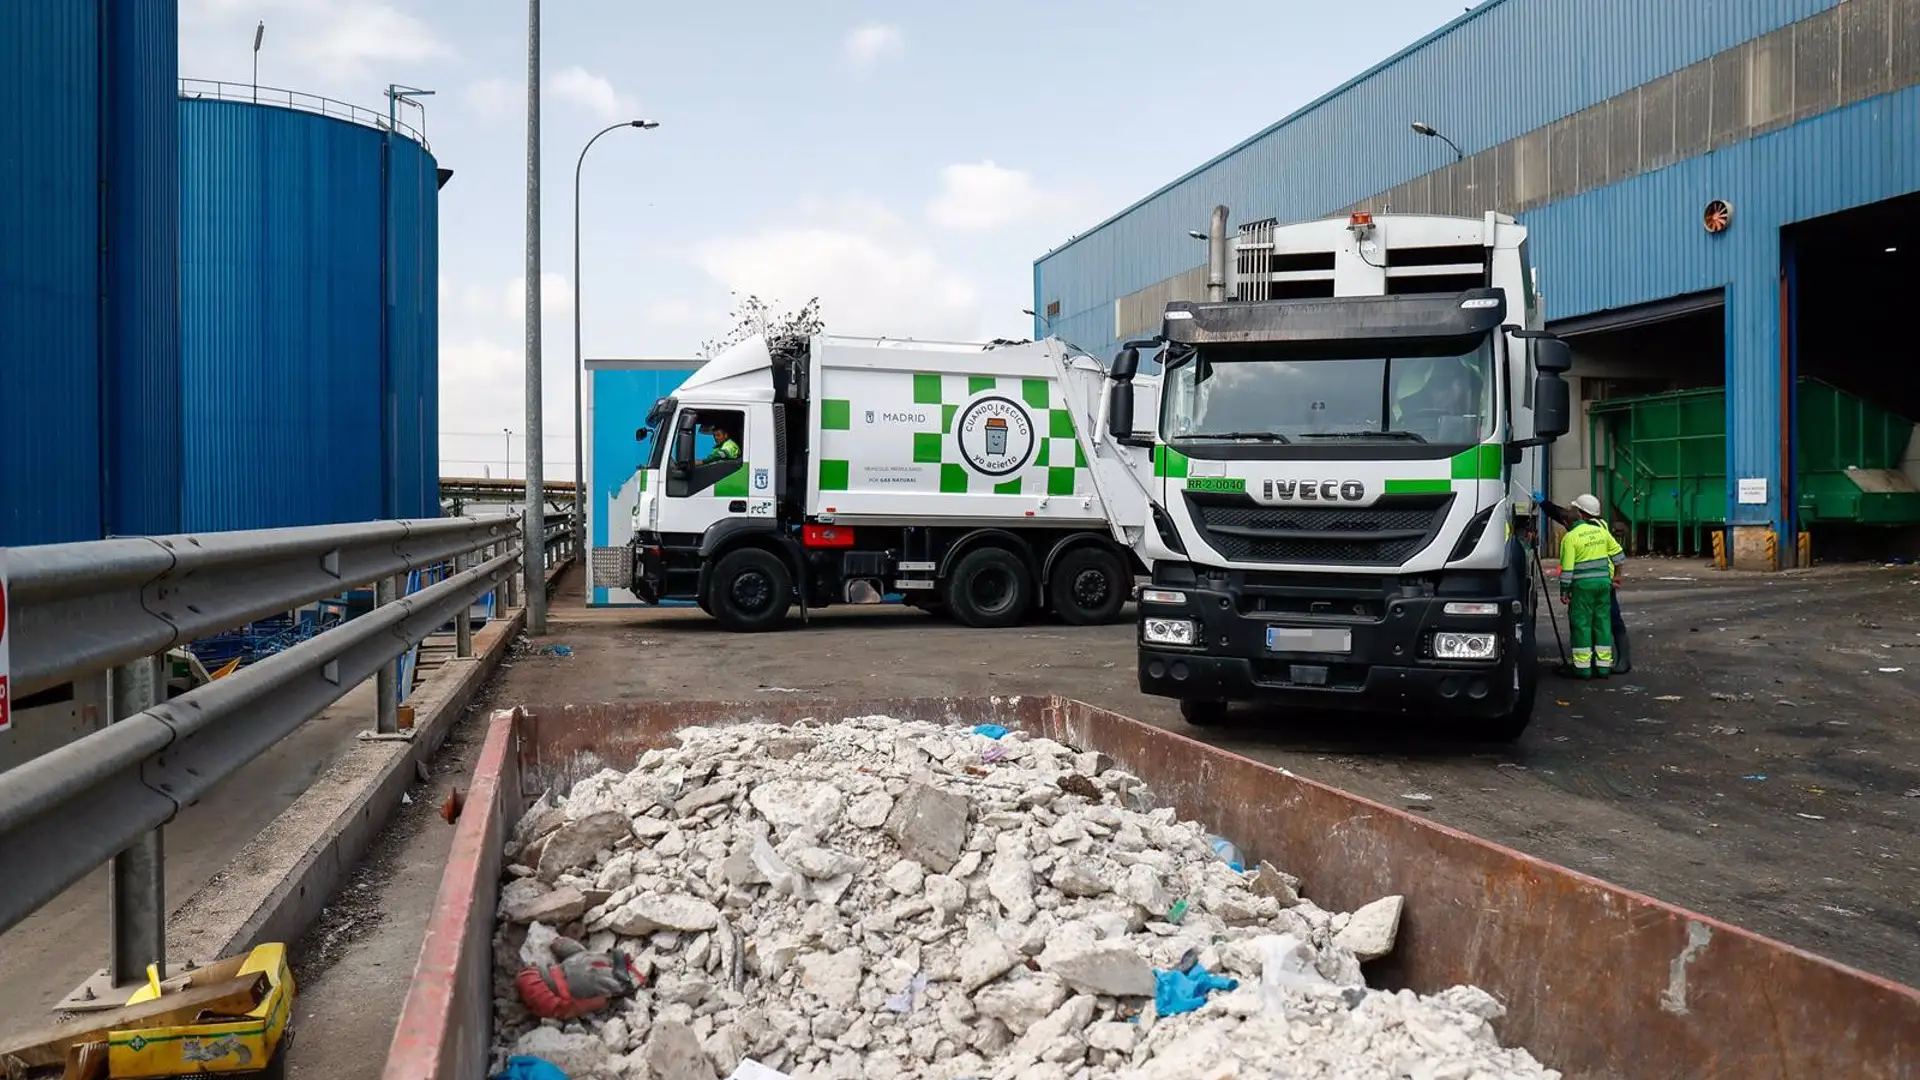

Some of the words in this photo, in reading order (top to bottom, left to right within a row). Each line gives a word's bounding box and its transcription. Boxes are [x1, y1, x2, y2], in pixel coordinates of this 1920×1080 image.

[882, 412, 926, 423] MADRID
[966, 403, 994, 433] CUANDO
[1000, 404, 1028, 436] RECICLO
[973, 454, 985, 465] yo
[986, 455, 1018, 469] acierto
[1263, 479, 1365, 501] IVECO
